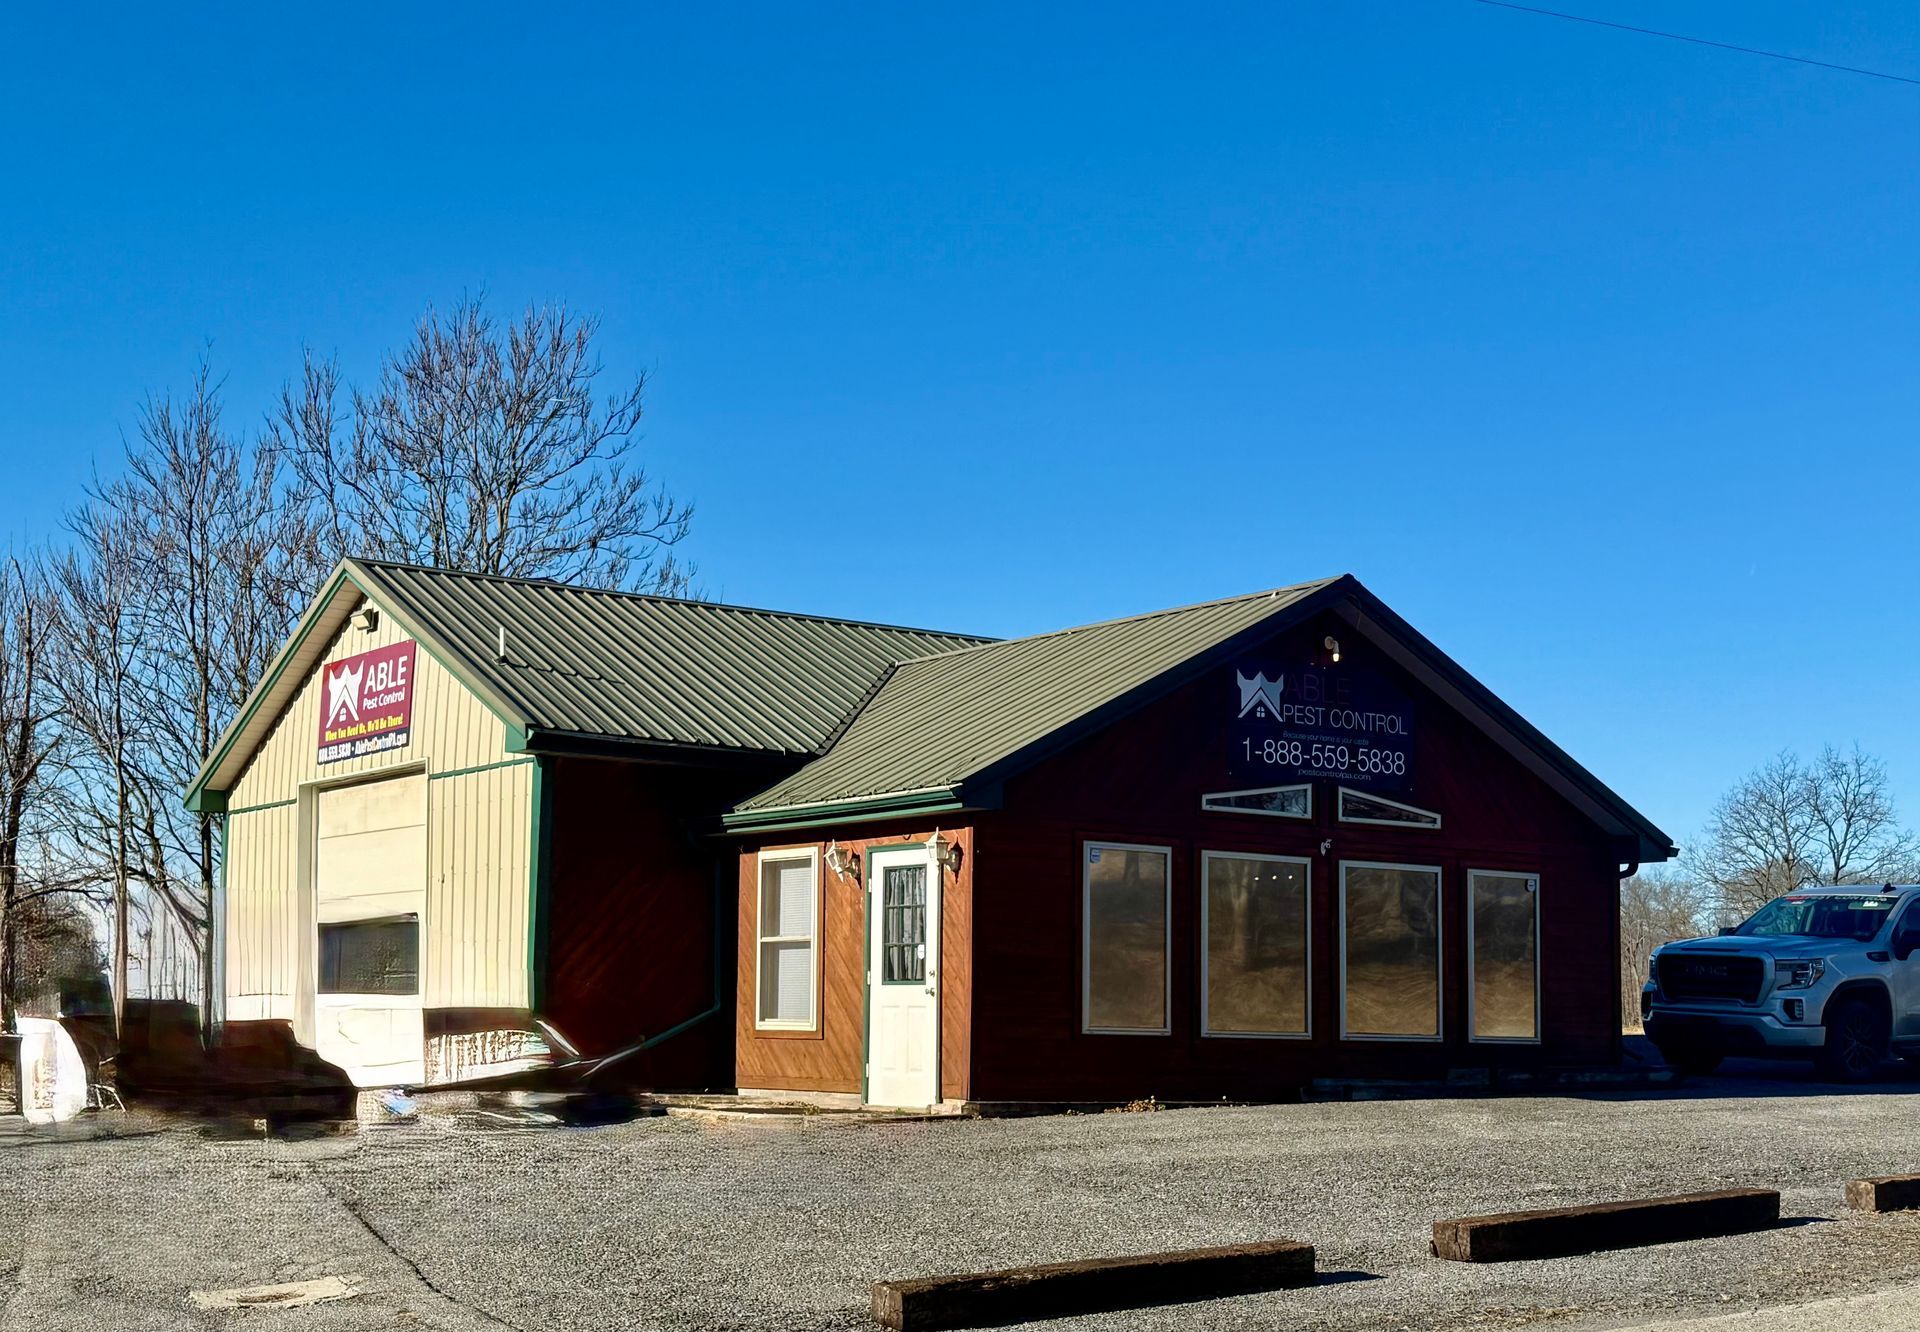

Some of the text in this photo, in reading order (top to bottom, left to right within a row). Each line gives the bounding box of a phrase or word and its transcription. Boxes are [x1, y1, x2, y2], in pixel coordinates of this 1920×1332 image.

[364, 655, 408, 695] ABLE
[1285, 673, 1353, 705] ABLE
[362, 686, 406, 711] Pest Control
[1283, 704, 1408, 735] PEST CONTROL
[1242, 737, 1406, 776] 1-888-559-5838
[1297, 769, 1372, 781] pestcontrolpa.com
